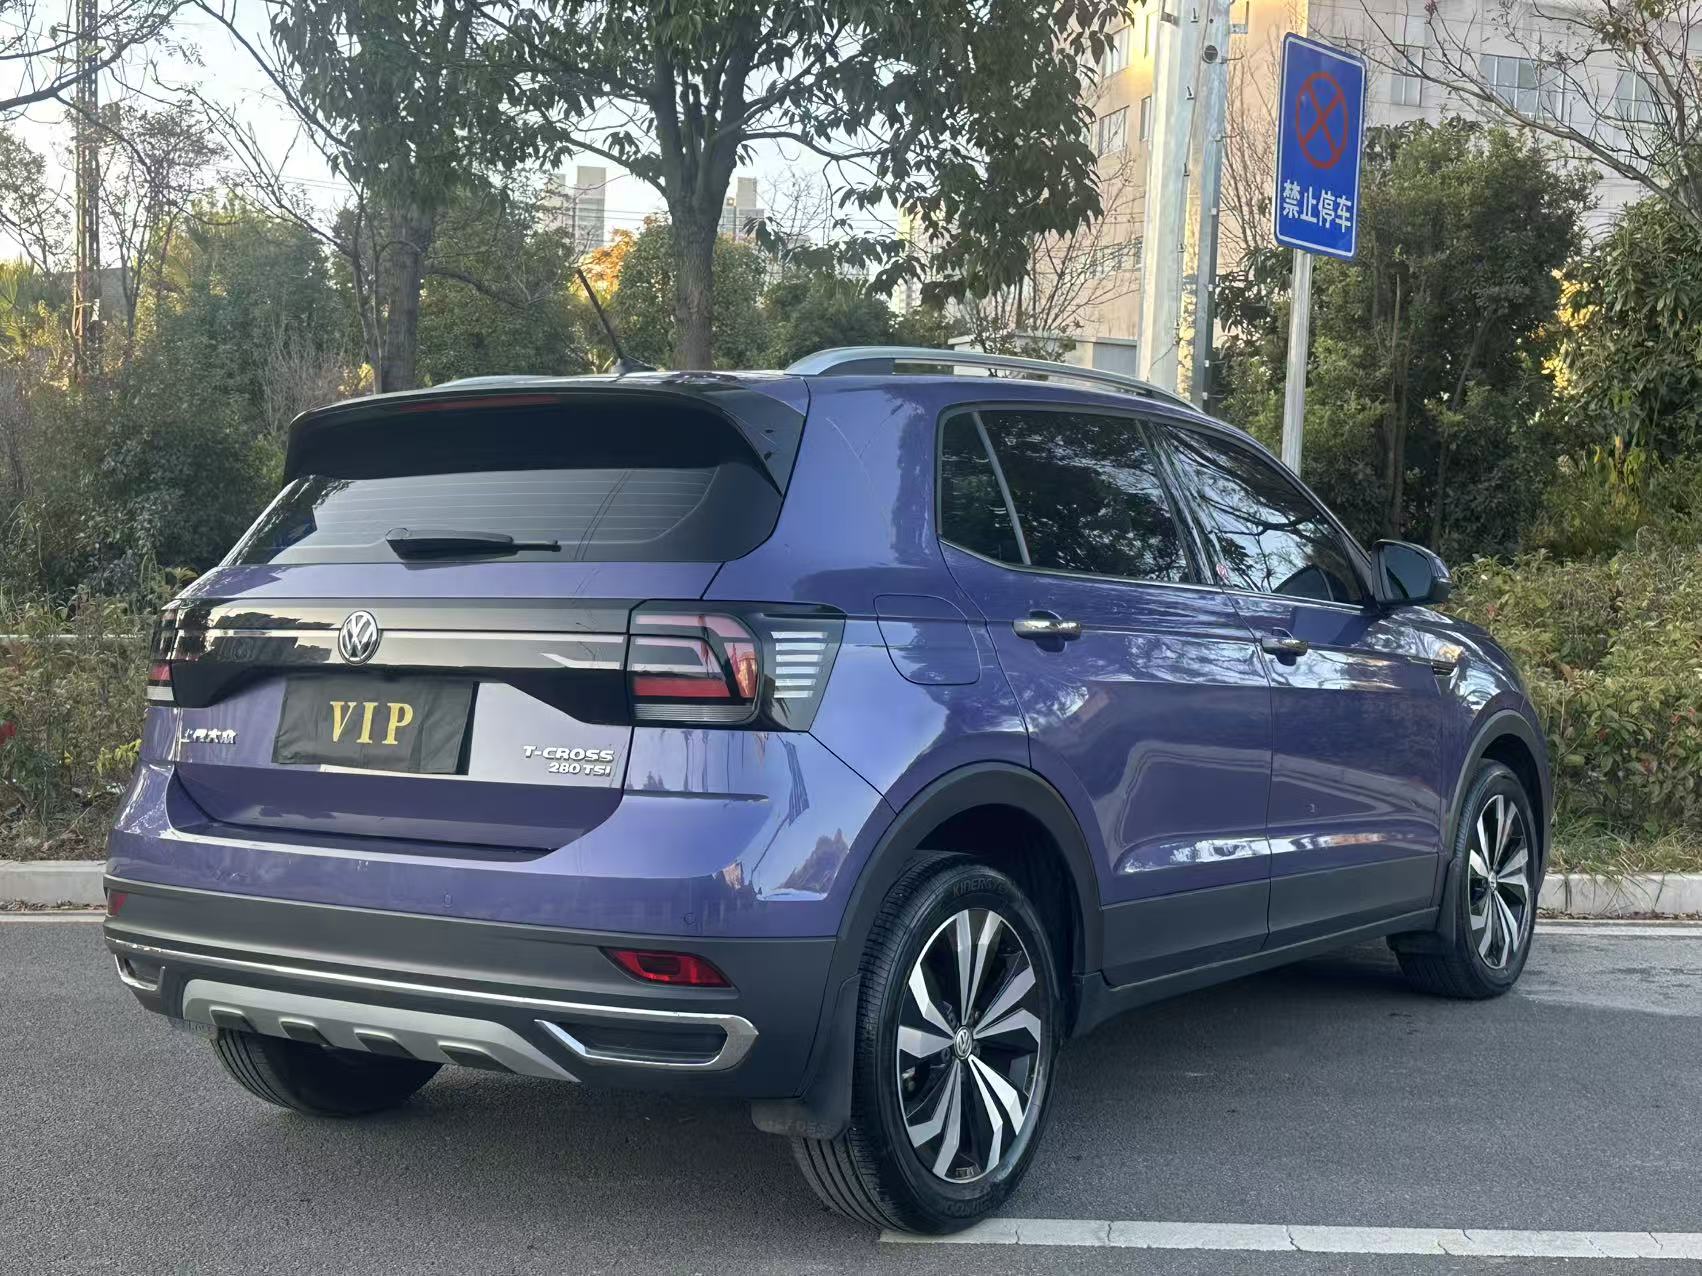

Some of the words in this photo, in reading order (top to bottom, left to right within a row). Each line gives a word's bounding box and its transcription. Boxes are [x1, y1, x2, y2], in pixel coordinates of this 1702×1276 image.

[1283, 179, 1352, 233] 禁止停车
[330, 701, 414, 744] VIP
[523, 745, 615, 762] T-CROSS
[548, 762, 581, 774] 280
[583, 764, 611, 777] TSI
